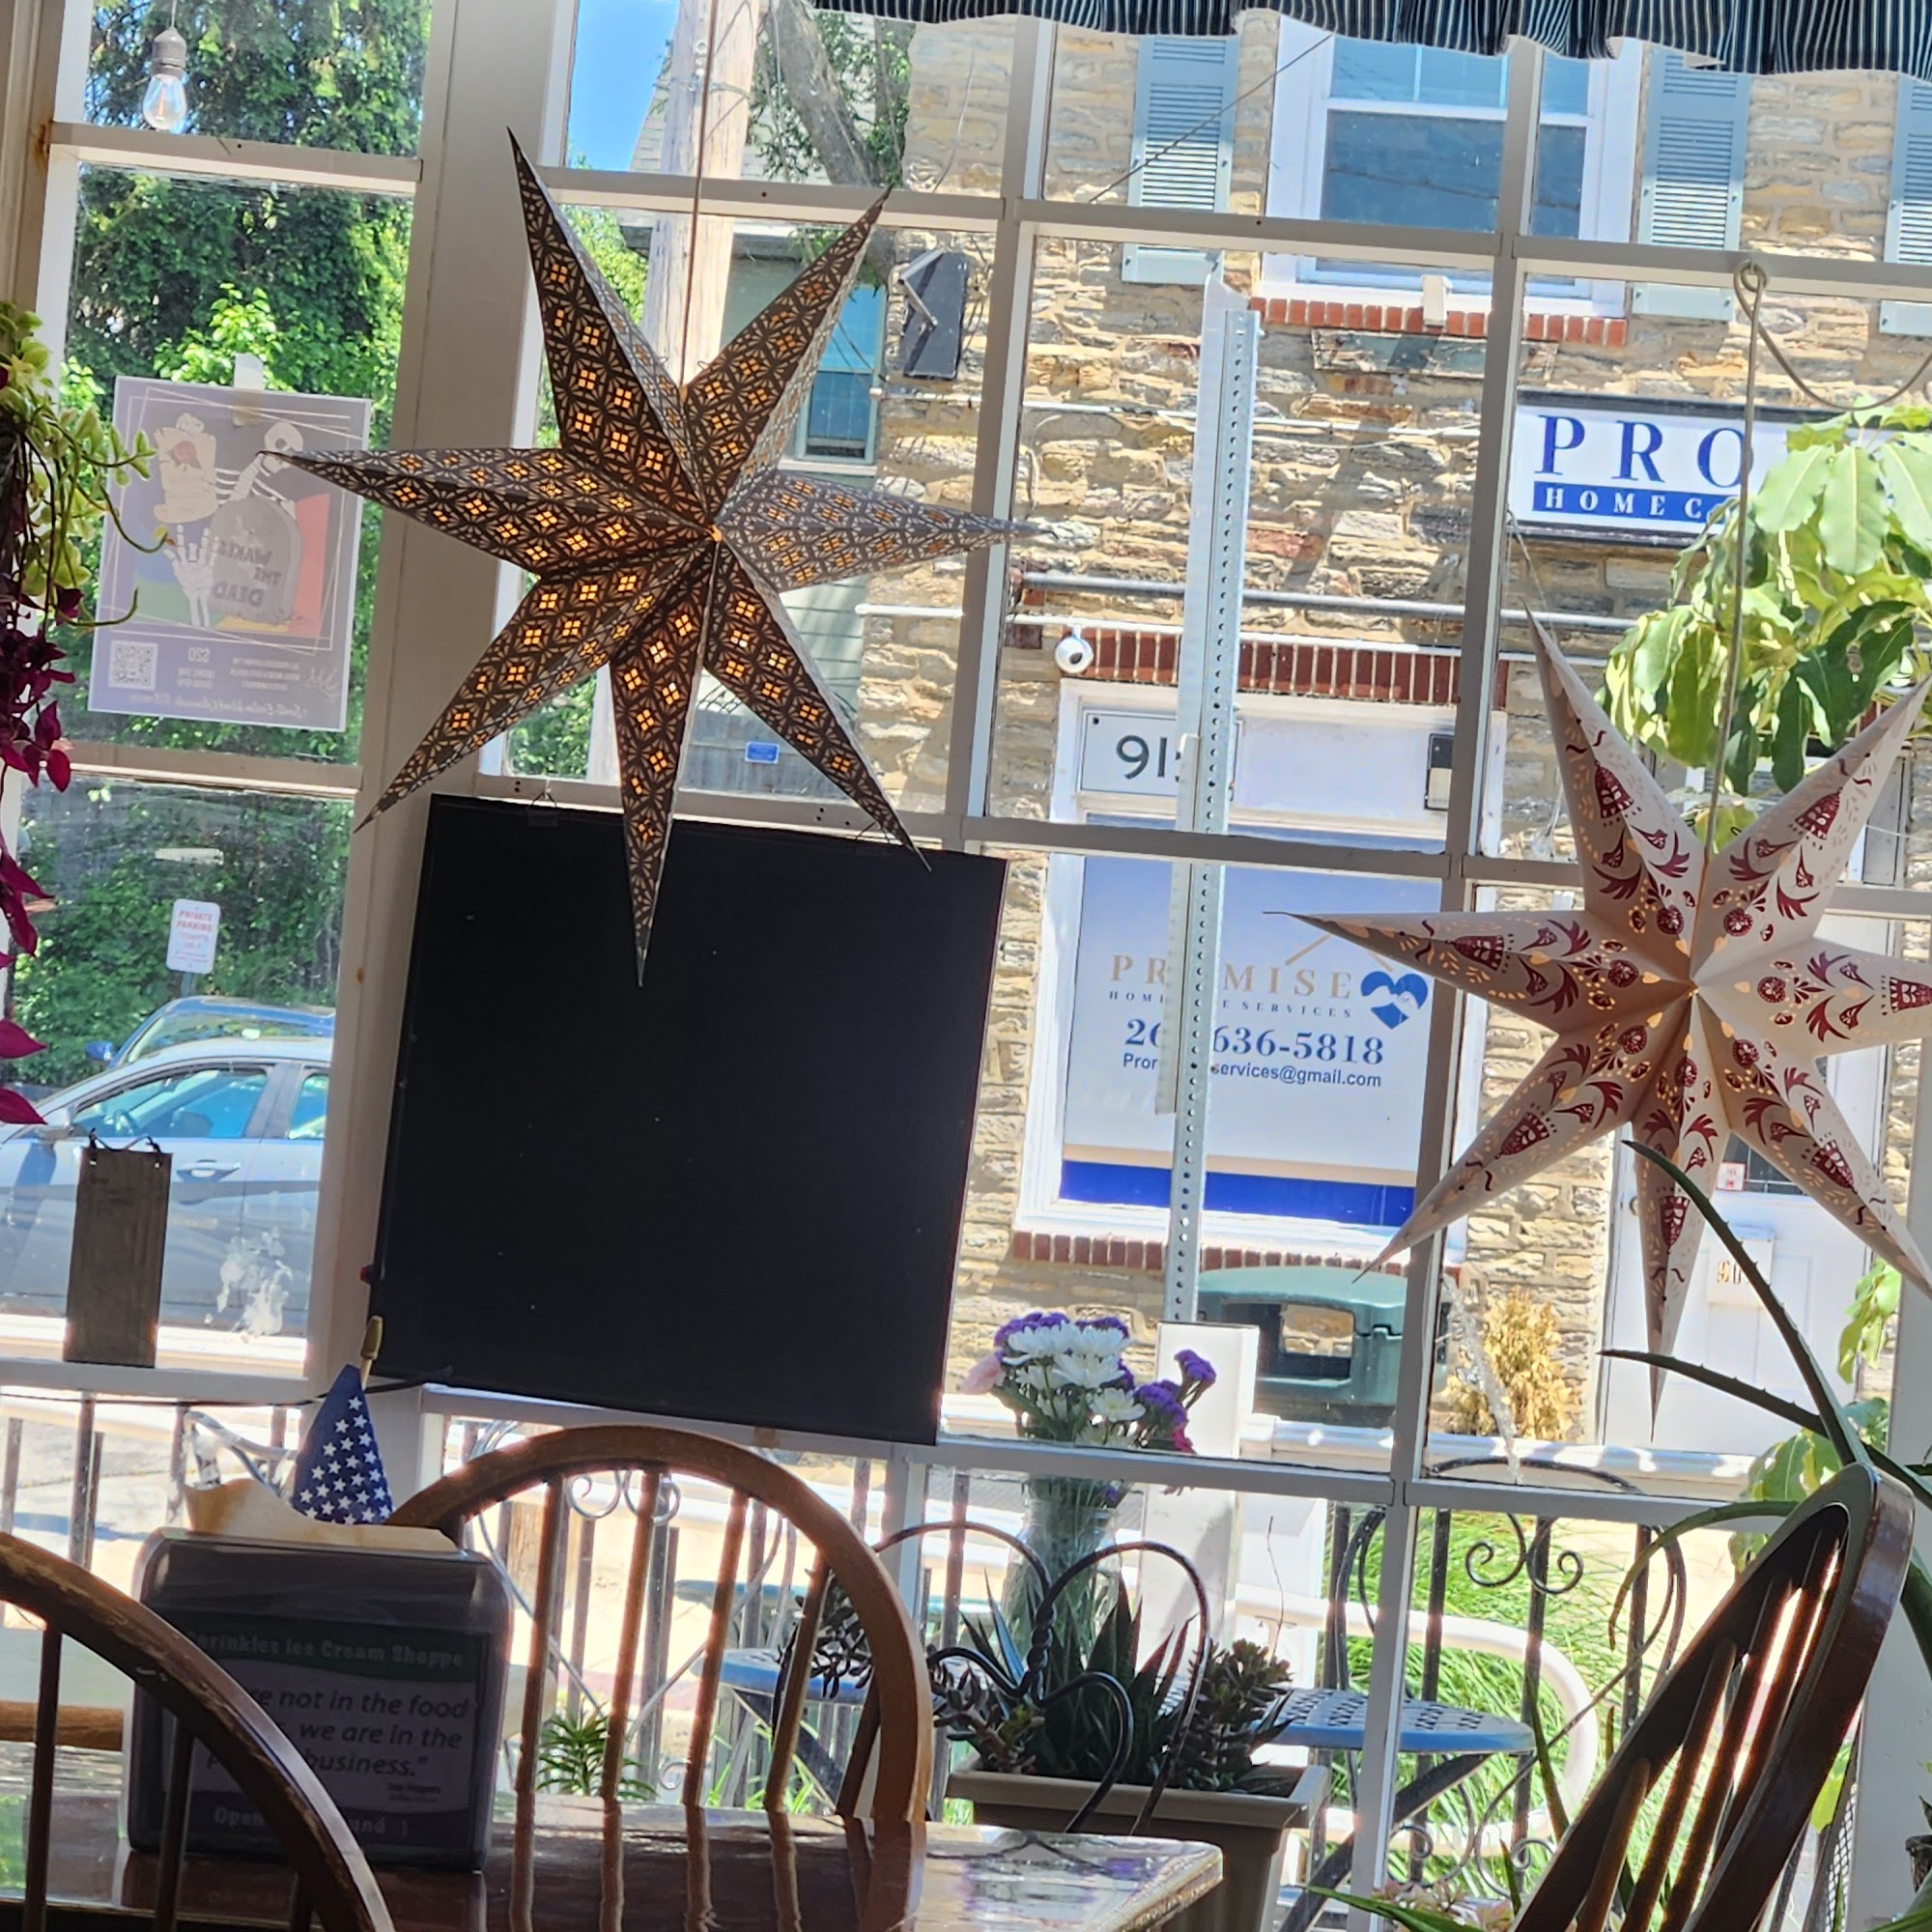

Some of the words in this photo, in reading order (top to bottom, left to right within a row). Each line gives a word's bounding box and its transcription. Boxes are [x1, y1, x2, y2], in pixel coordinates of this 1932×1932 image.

[1534, 413, 1753, 488] PRO
[1117, 734, 1180, 781] 91
[1110, 953, 1351, 1000] PRMISE
[1242, 1001, 1351, 1018] SERVICES
[286, 1638, 314, 1657] Ice
[322, 1638, 385, 1662] Cream
[392, 1645, 463, 1669] Shoppe
[279, 1692, 323, 1710] not
[329, 1690, 354, 1711] in
[362, 1692, 403, 1716] the
[410, 1696, 470, 1719] food
[300, 1724, 335, 1742] we
[342, 1727, 388, 1745] are
[390, 1724, 413, 1746] in
[422, 1727, 464, 1749] the
